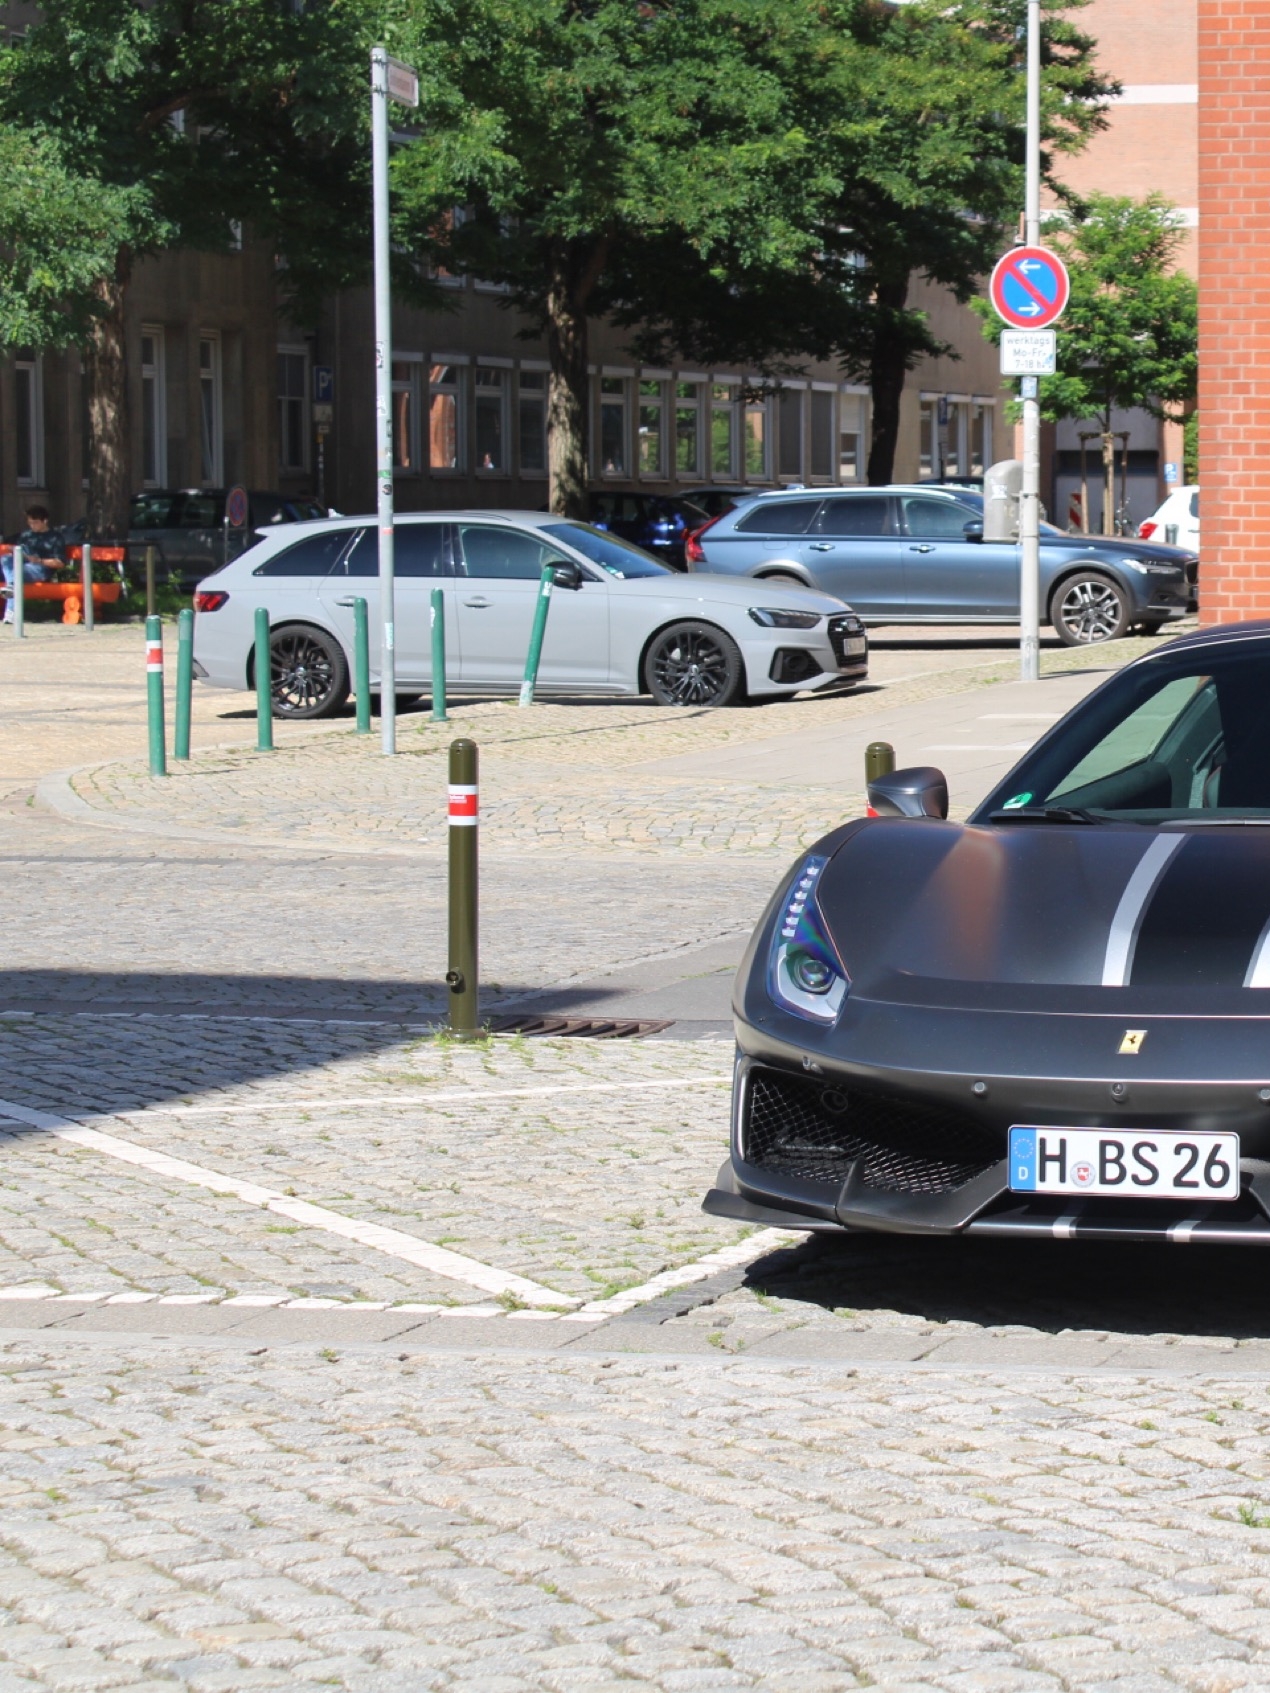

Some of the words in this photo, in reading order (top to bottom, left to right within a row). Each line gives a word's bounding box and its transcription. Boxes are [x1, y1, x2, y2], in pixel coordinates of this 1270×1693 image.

[1007, 336, 1051, 347] werktags
[1039, 1137, 1067, 1184] H
[1099, 1139, 1160, 1187] BS
[1172, 1142, 1231, 1189] 26
[1018, 1166, 1029, 1181] D
